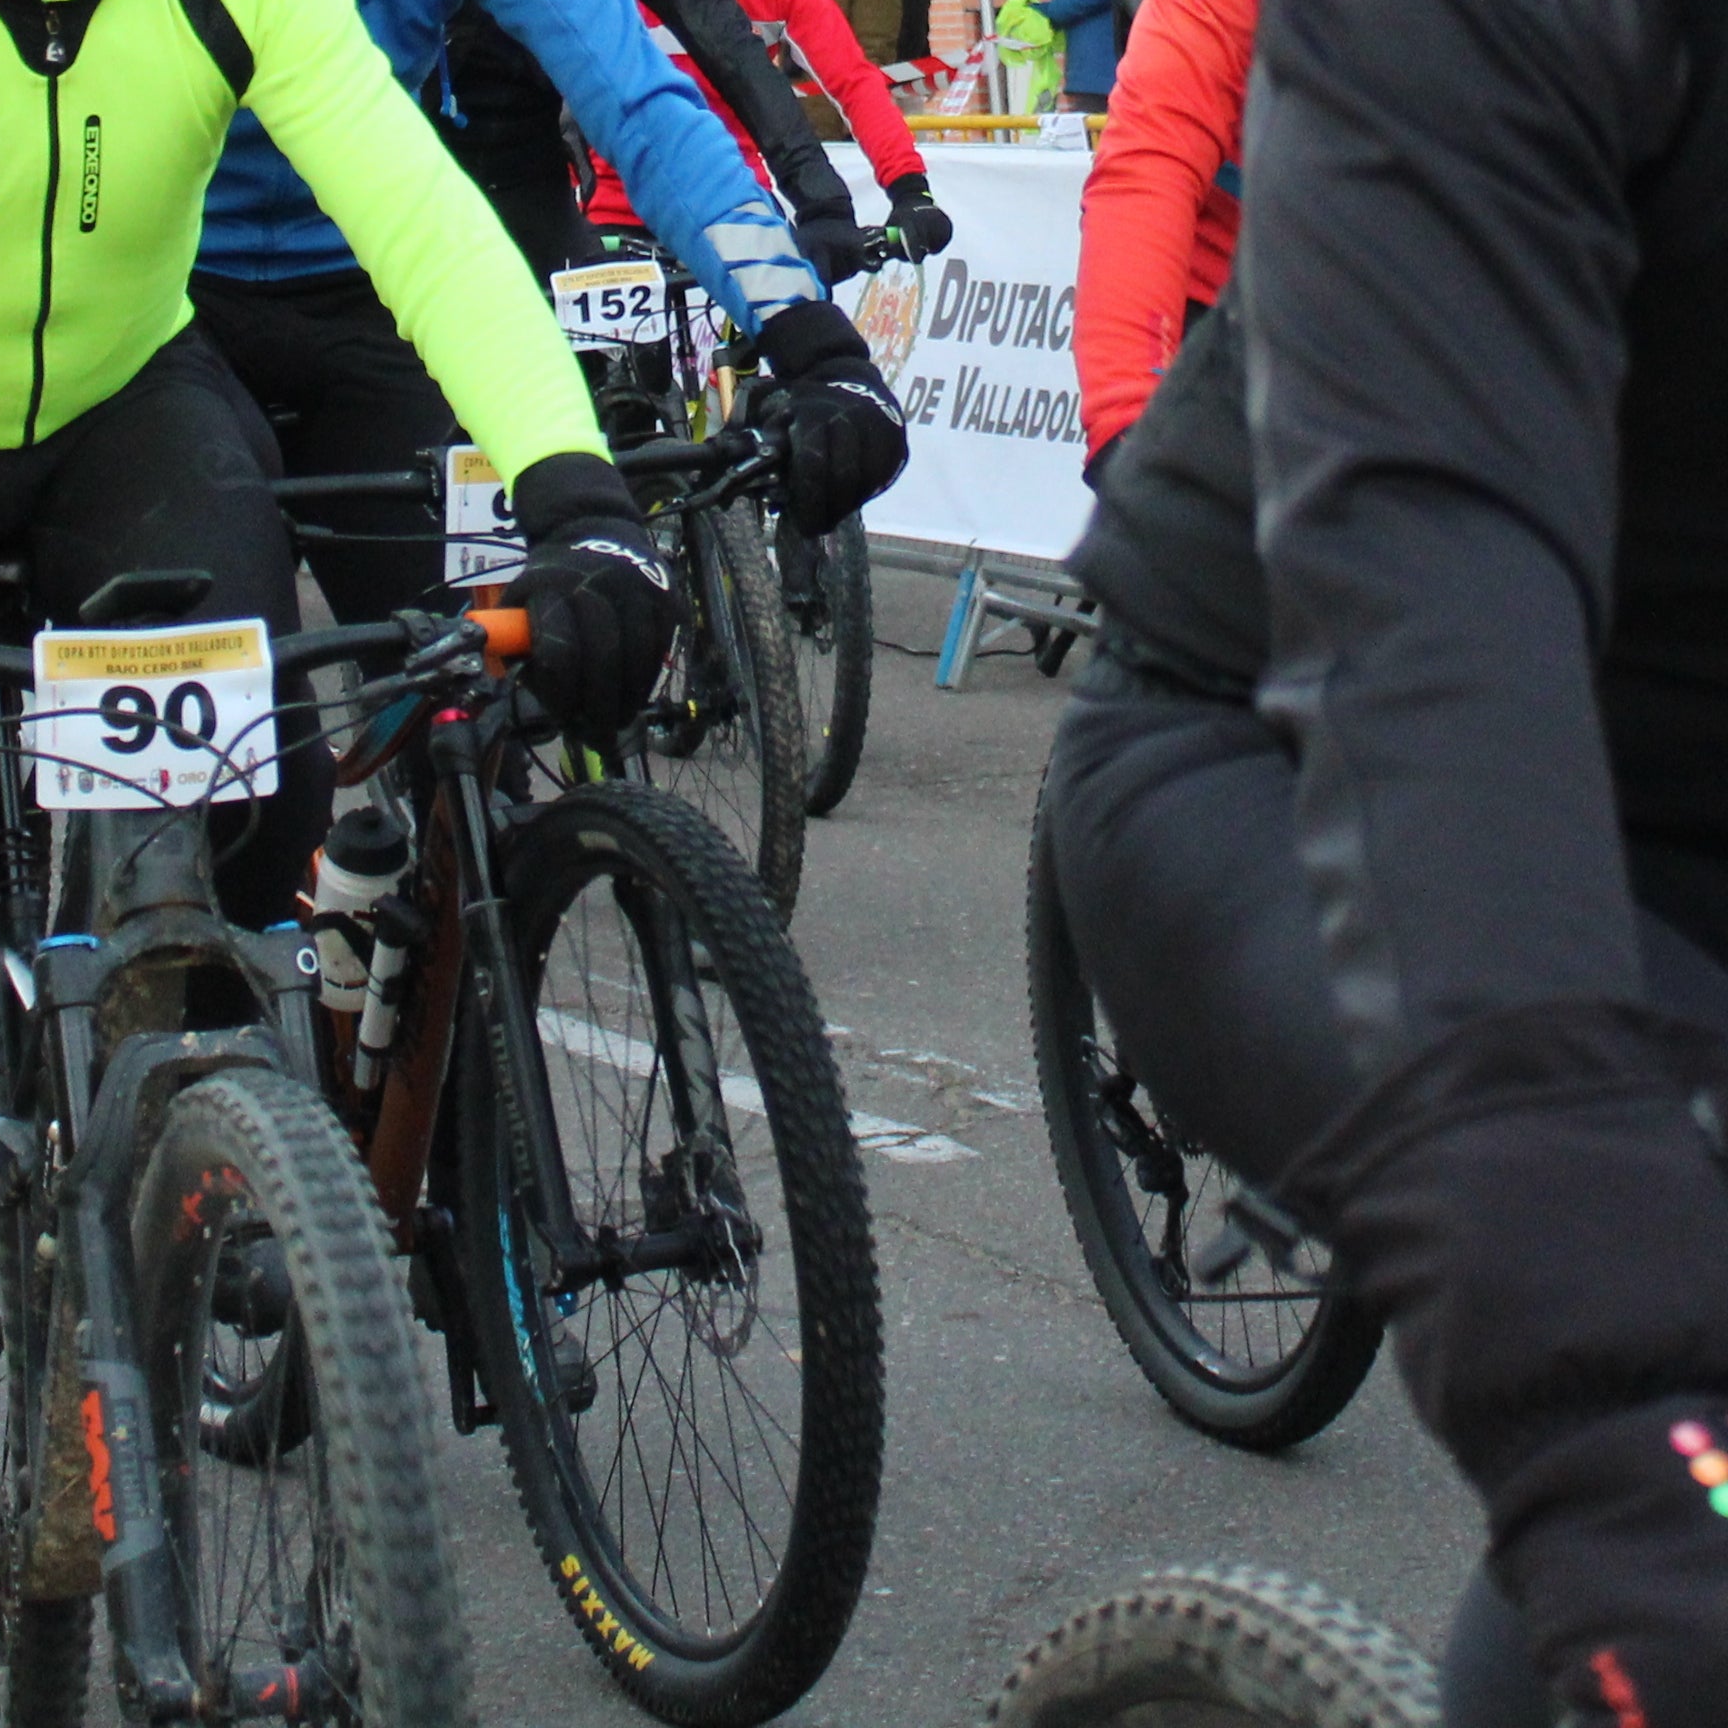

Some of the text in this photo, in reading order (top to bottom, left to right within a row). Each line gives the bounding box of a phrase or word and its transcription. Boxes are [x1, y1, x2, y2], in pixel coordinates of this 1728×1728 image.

[81, 125, 99, 223] ETXEONDO
[573, 284, 652, 324] 152
[927, 258, 1076, 352] DIPUTAC
[904, 376, 945, 425] DE
[58, 646, 84, 659] COPA
[106, 662, 138, 675] BAJO
[143, 660, 177, 674] CERO
[99, 680, 217, 754] 90
[560, 1553, 656, 1671] MAXXIS
